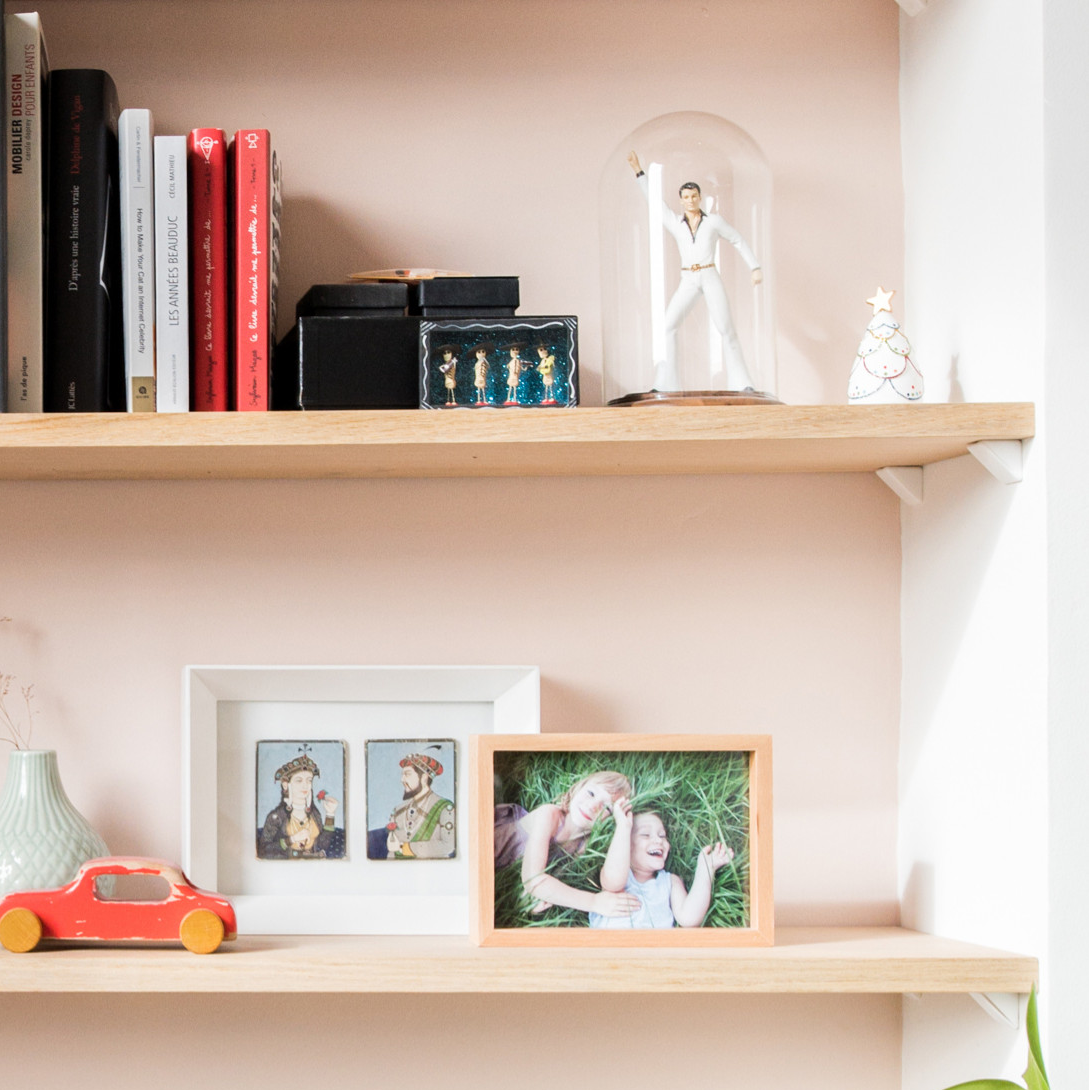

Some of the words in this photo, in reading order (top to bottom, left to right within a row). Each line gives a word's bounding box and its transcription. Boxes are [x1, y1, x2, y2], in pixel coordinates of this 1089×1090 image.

[24, 44, 35, 88] ENFANTS
[12, 74, 22, 116] DESIGN
[24, 90, 35, 116] POUR
[71, 95, 84, 121] Vigan
[12, 120, 23, 174] MOBILIER
[70, 134, 83, 174] Delphine
[71, 185, 79, 205] vraie
[69, 208, 79, 239] histoire
[71, 241, 79, 256] une
[168, 216, 178, 264] BEAUDUC
[249, 218, 261, 256] permettre
[68, 259, 81, 291] D'après
[251, 258, 258, 272] me
[138, 285, 144, 294] an
[167, 267, 179, 307] ANNÉES
[169, 310, 179, 326] LES
[137, 323, 146, 354] Celebrity
[250, 333, 258, 342] Ce
[21, 356, 29, 376] pique
[20, 378, 27, 388] de
[68, 382, 76, 402] Lattès
